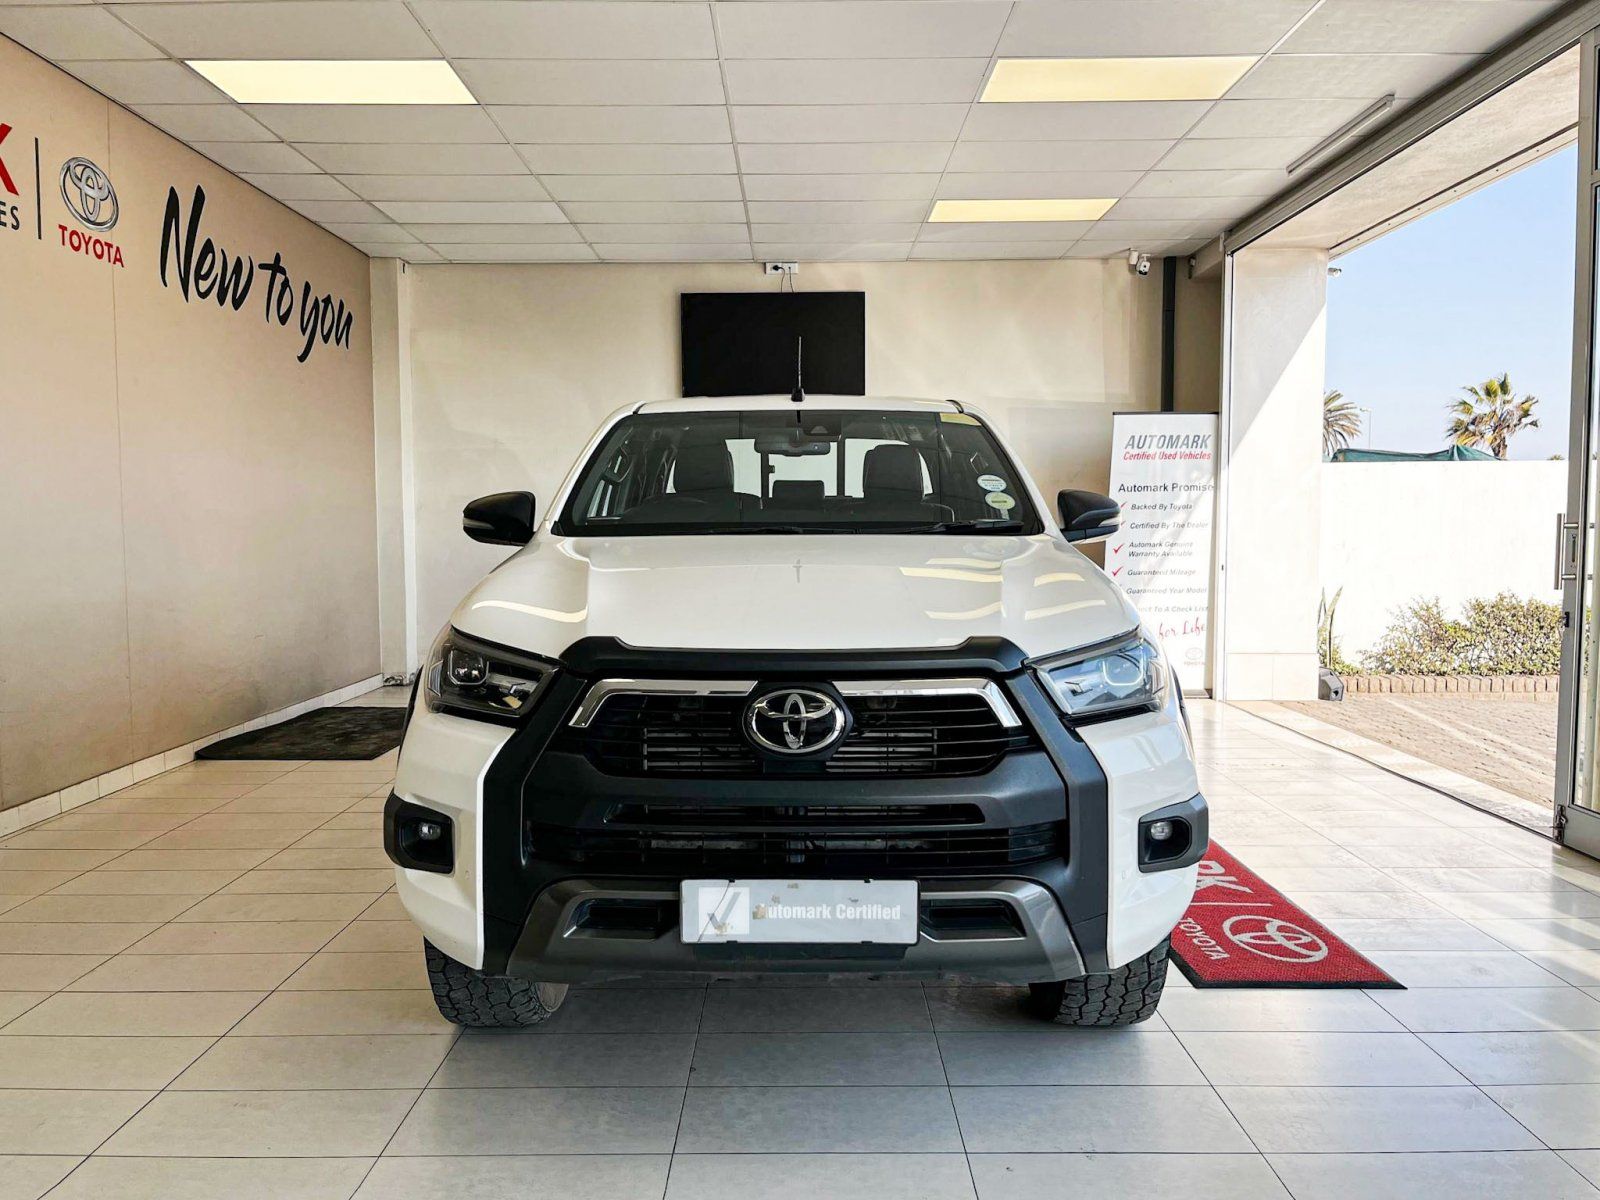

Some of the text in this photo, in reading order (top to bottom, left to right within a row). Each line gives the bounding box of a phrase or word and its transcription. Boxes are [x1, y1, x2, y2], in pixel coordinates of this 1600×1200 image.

[58, 224, 125, 268] TOYOTA
[160, 184, 353, 363] New to you
[1125, 434, 1212, 449] AUTOMARK
[1123, 451, 1212, 461] Certified Used Vehicles
[1118, 483, 1168, 493] Automark
[1131, 503, 1193, 511] Backed By Toyota
[1130, 521, 1208, 531] Certified By The Dealer
[1169, 568, 1196, 577] Mileage
[1126, 587, 1167, 595] Guaranteed
[1186, 586, 1207, 594] Model
[1183, 616, 1205, 637] Life
[836, 904, 901, 920] Certified
[1179, 917, 1230, 960] TOYOTA
